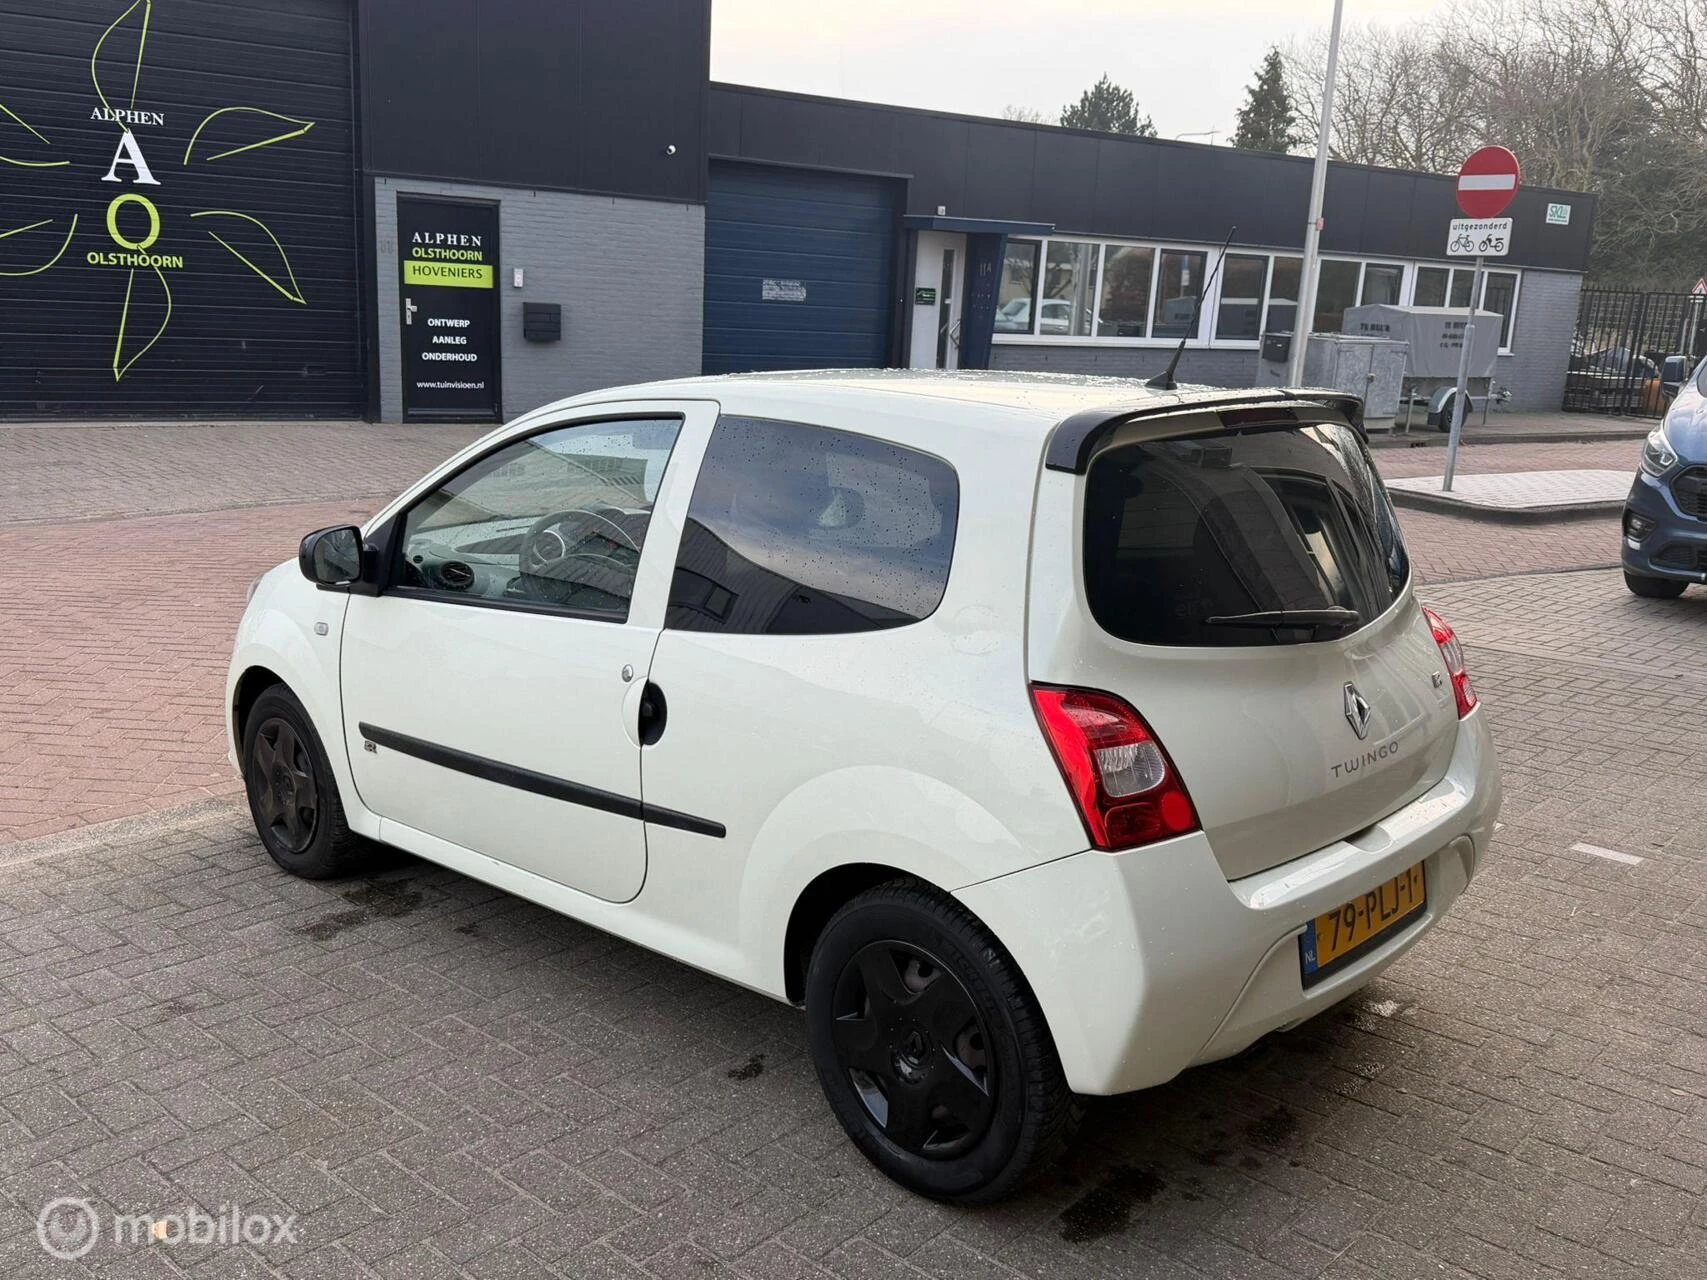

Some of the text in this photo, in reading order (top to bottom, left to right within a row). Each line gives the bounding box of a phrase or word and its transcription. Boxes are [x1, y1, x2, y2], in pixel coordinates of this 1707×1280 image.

[90, 107, 165, 126] ALPHEN
[101, 128, 162, 186] A
[106, 193, 161, 251] O
[1452, 222, 1508, 232] uitgezonderd
[411, 231, 482, 247] ALPHEN
[86, 251, 184, 269] OLSTHOORN
[411, 247, 483, 261] OLSTHOORN
[412, 265, 483, 280] HOVENIERS
[427, 318, 471, 328] ONTWERP
[432, 335, 467, 345] AANLEG
[421, 352, 478, 362] ONDERHOUD
[416, 380, 485, 389] www.tuinvisioen.nl
[1330, 741, 1399, 778] TWINGO
[1328, 867, 1413, 952] 79-PLJ-1
[1304, 950, 1316, 965] NL
